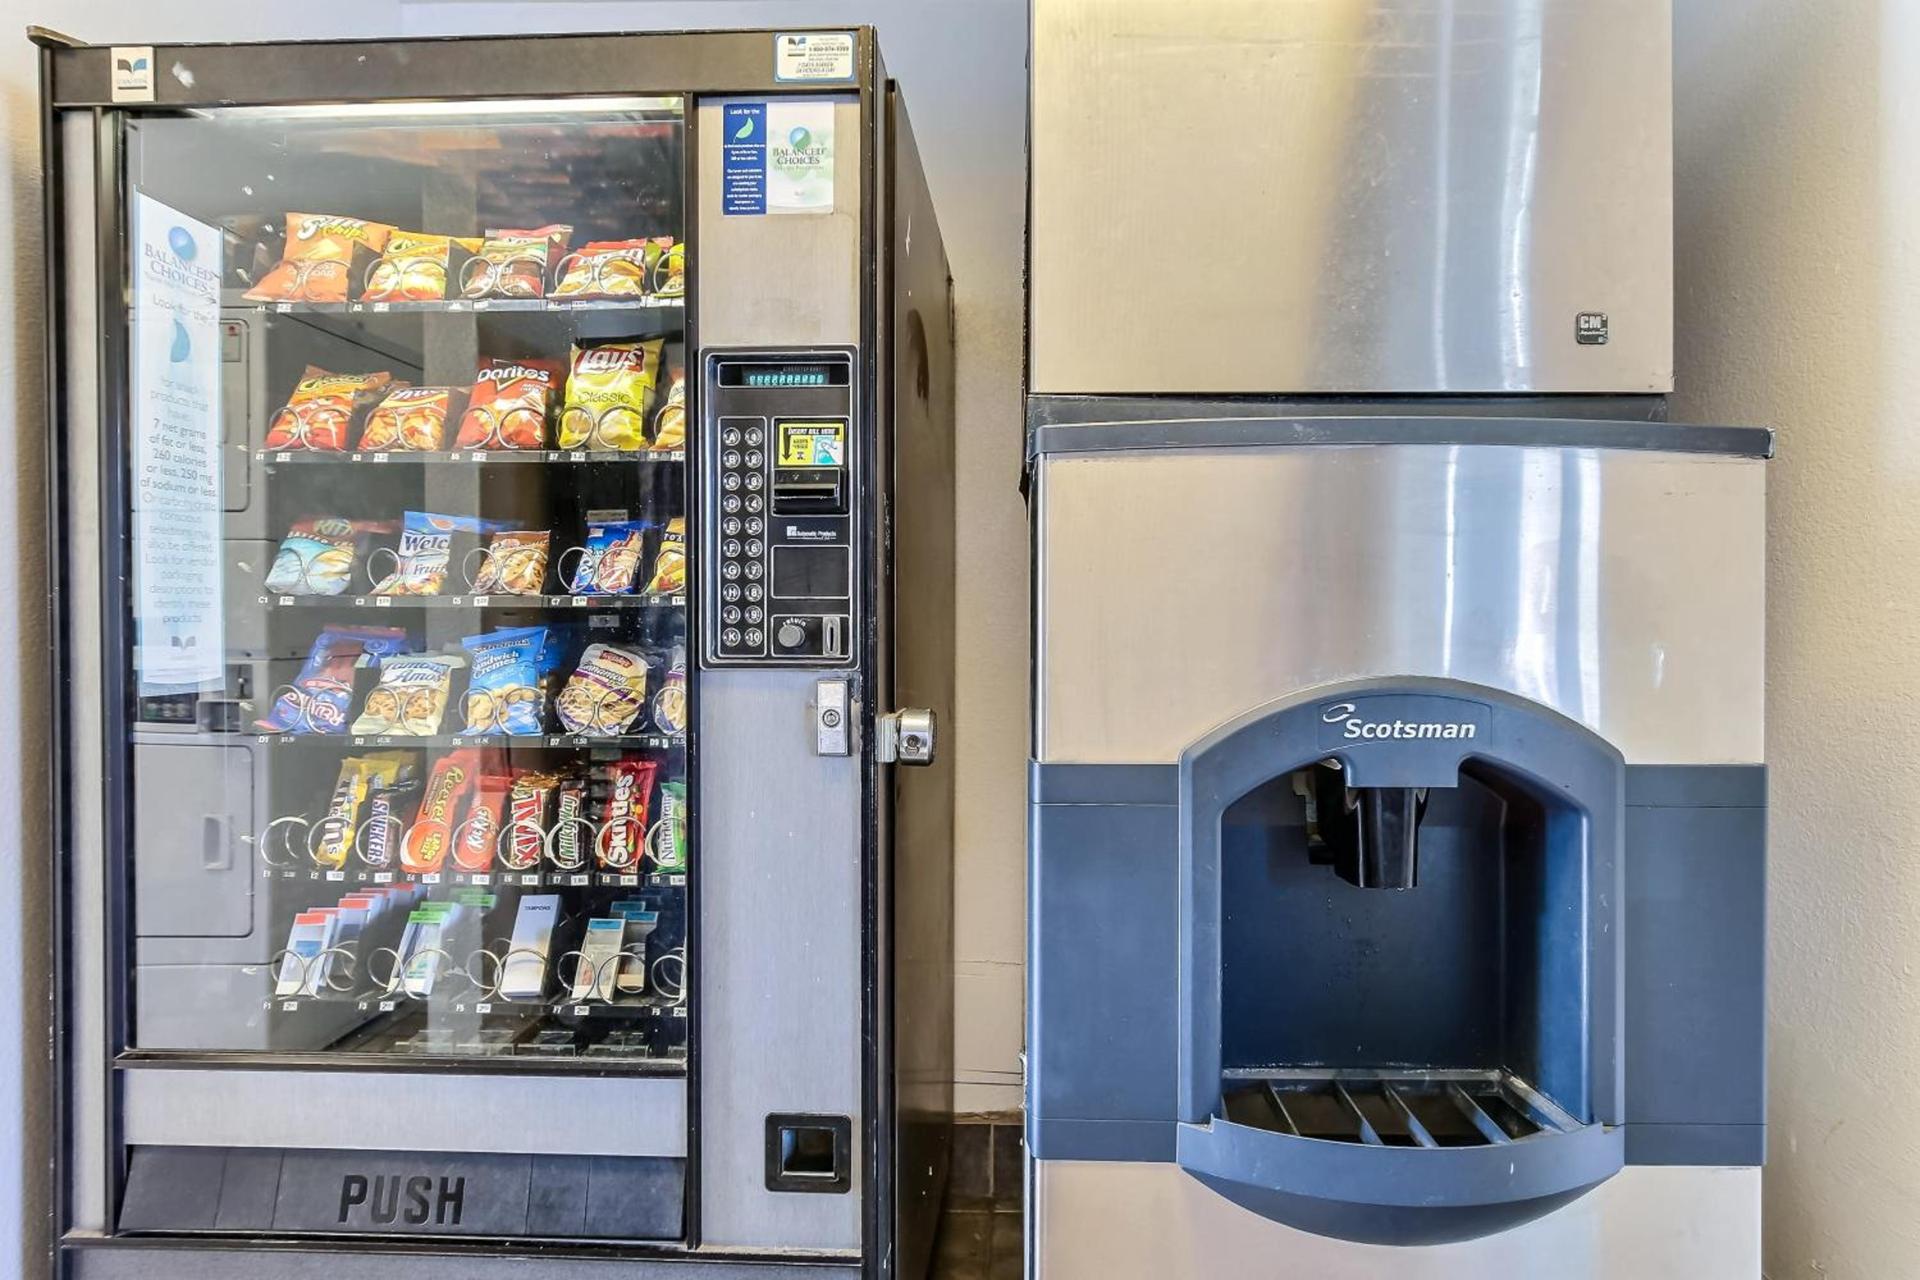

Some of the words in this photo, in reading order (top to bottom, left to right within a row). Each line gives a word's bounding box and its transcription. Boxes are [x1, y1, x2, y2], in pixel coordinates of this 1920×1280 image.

[773, 147, 825, 156] BALANCED
[777, 156, 820, 165] CHOICES
[144, 243, 215, 281] BALANCED
[151, 260, 208, 293] CHOICES
[477, 365, 549, 384] Doritos
[578, 391, 630, 404] Classic
[1343, 717, 1476, 739] Scotsman
[452, 738, 462, 746] D5
[550, 738, 560, 746] D7
[650, 738, 660, 746] D9
[561, 794, 580, 824] Way
[607, 774, 635, 865] Skittles
[367, 800, 391, 865] SNICKERS
[512, 790, 543, 866] TWIX
[559, 823, 579, 859] Milky
[338, 1174, 466, 1225] PUSH
